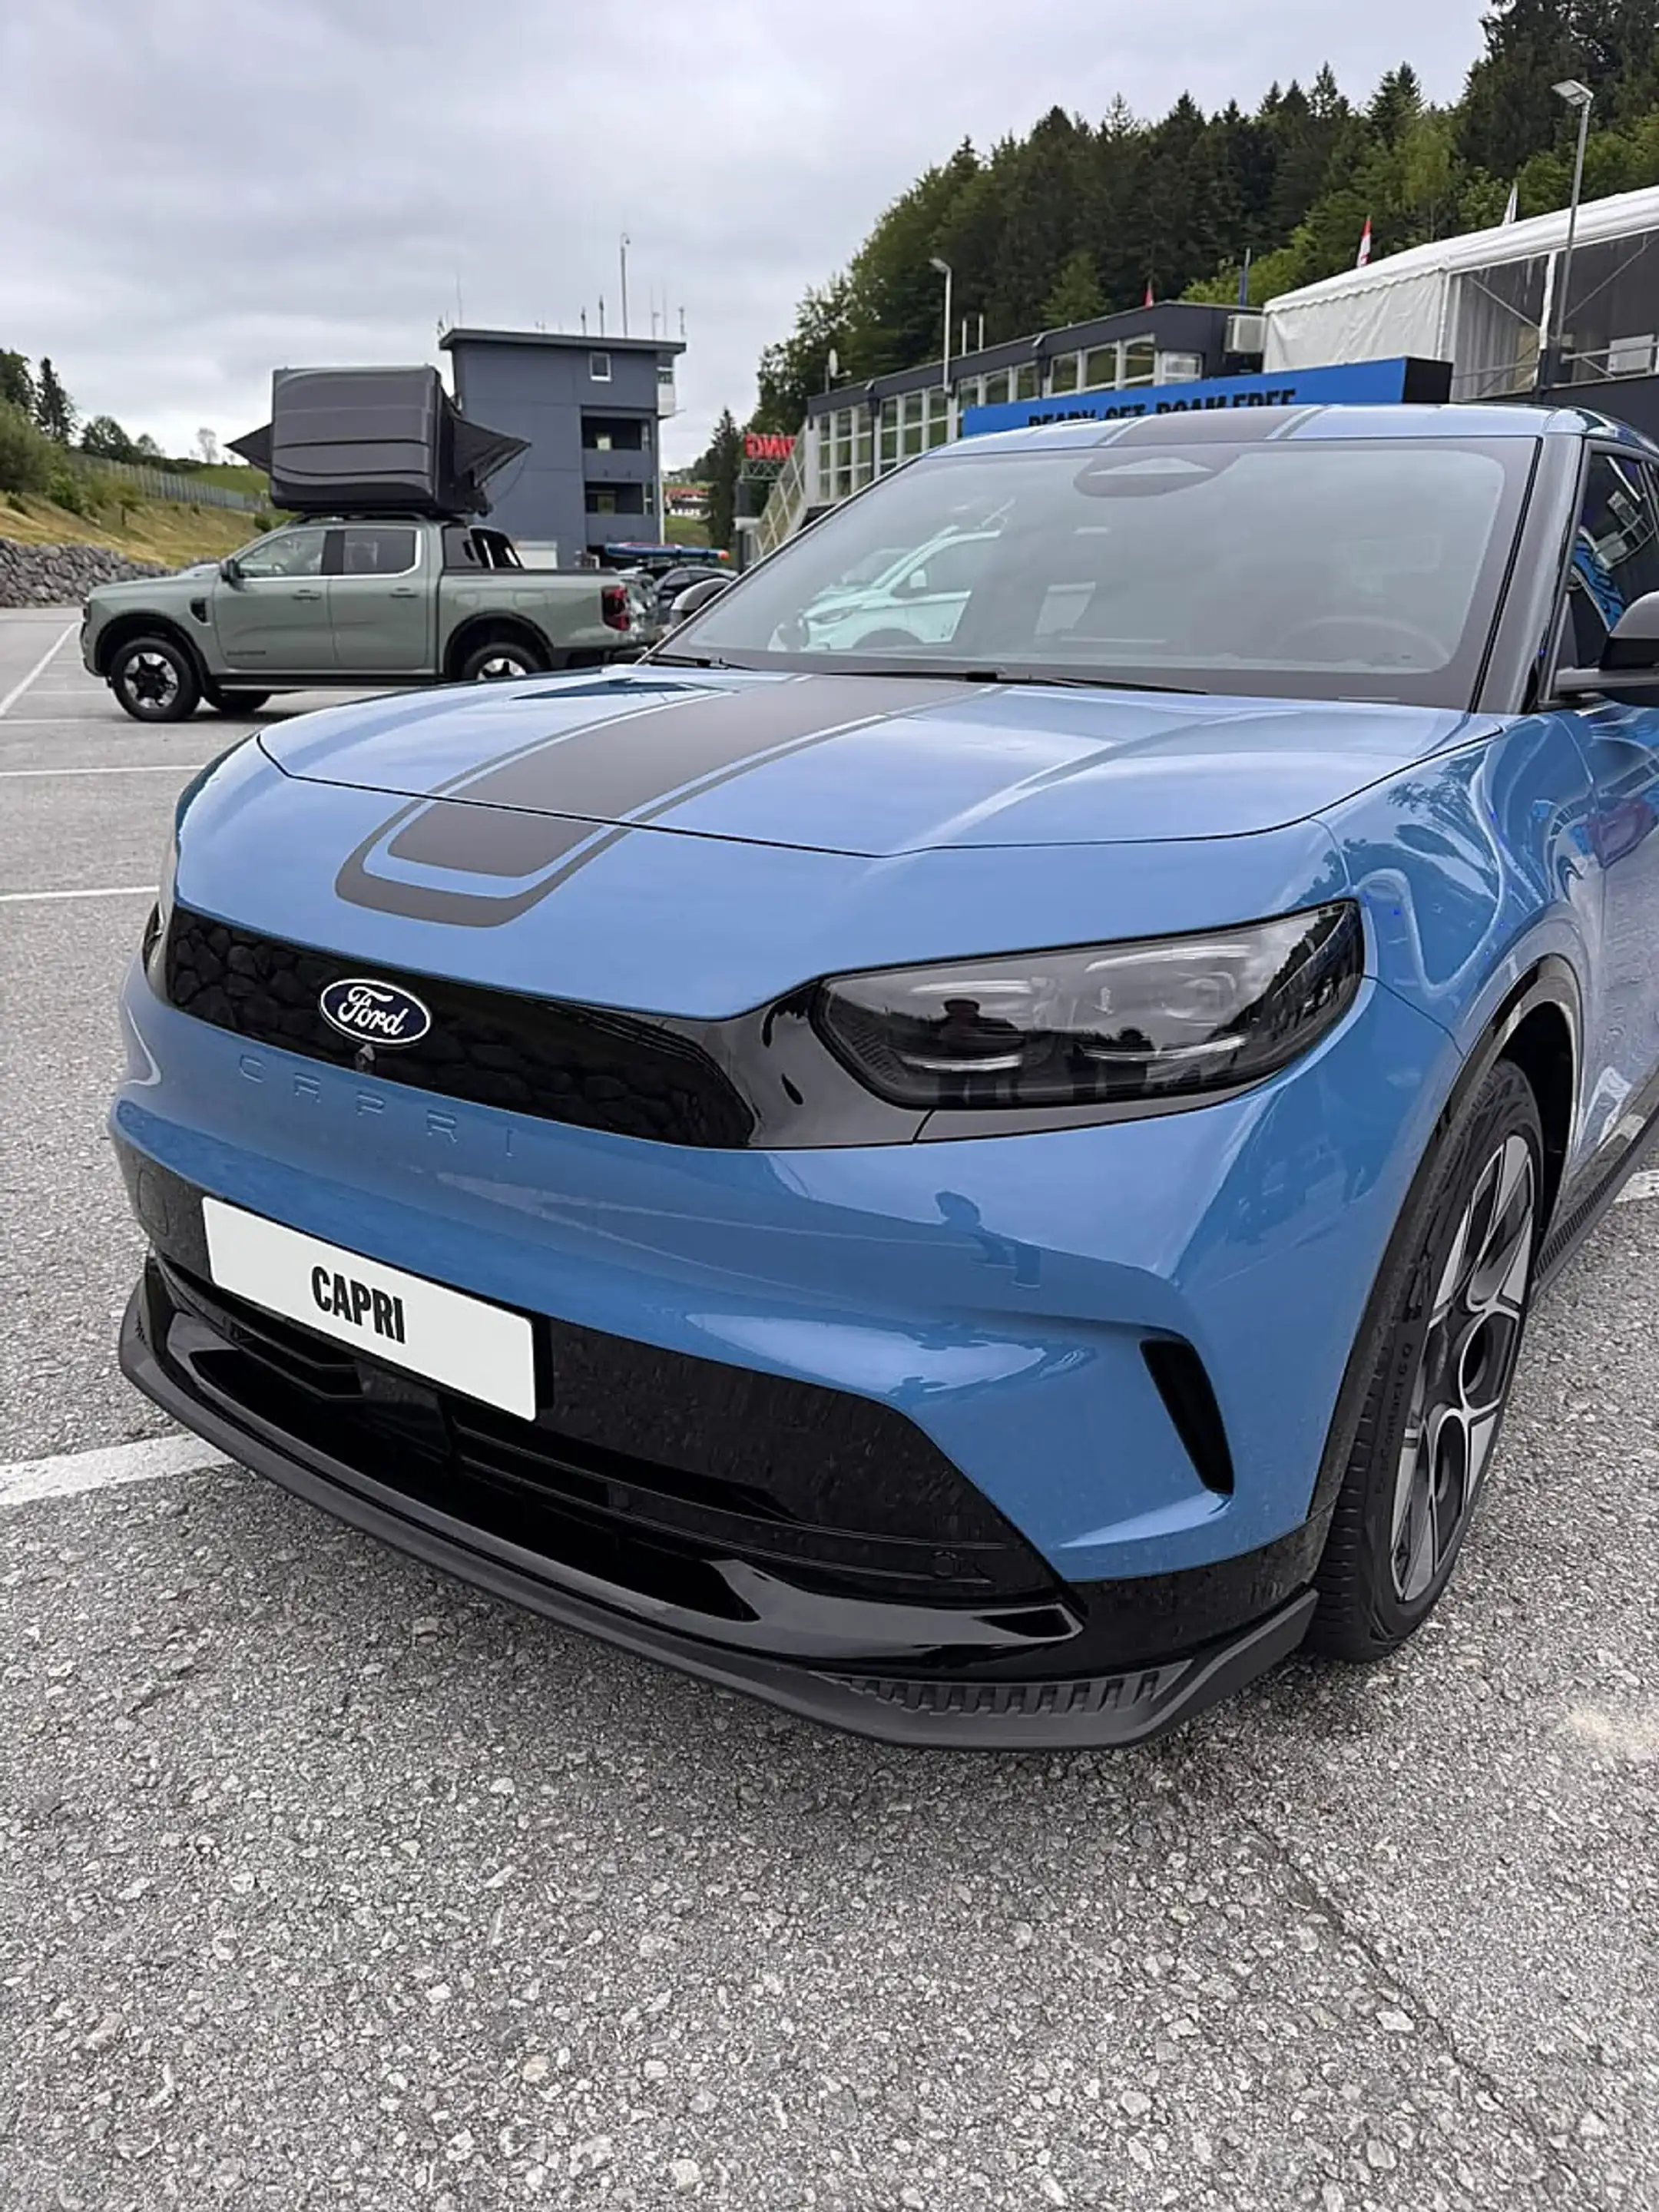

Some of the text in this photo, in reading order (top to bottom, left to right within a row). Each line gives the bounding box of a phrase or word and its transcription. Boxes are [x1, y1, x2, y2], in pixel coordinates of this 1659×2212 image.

[338, 986, 409, 1035] Ford
[240, 1054, 513, 1157] CAPRI
[311, 1266, 405, 1344] CAPRI
